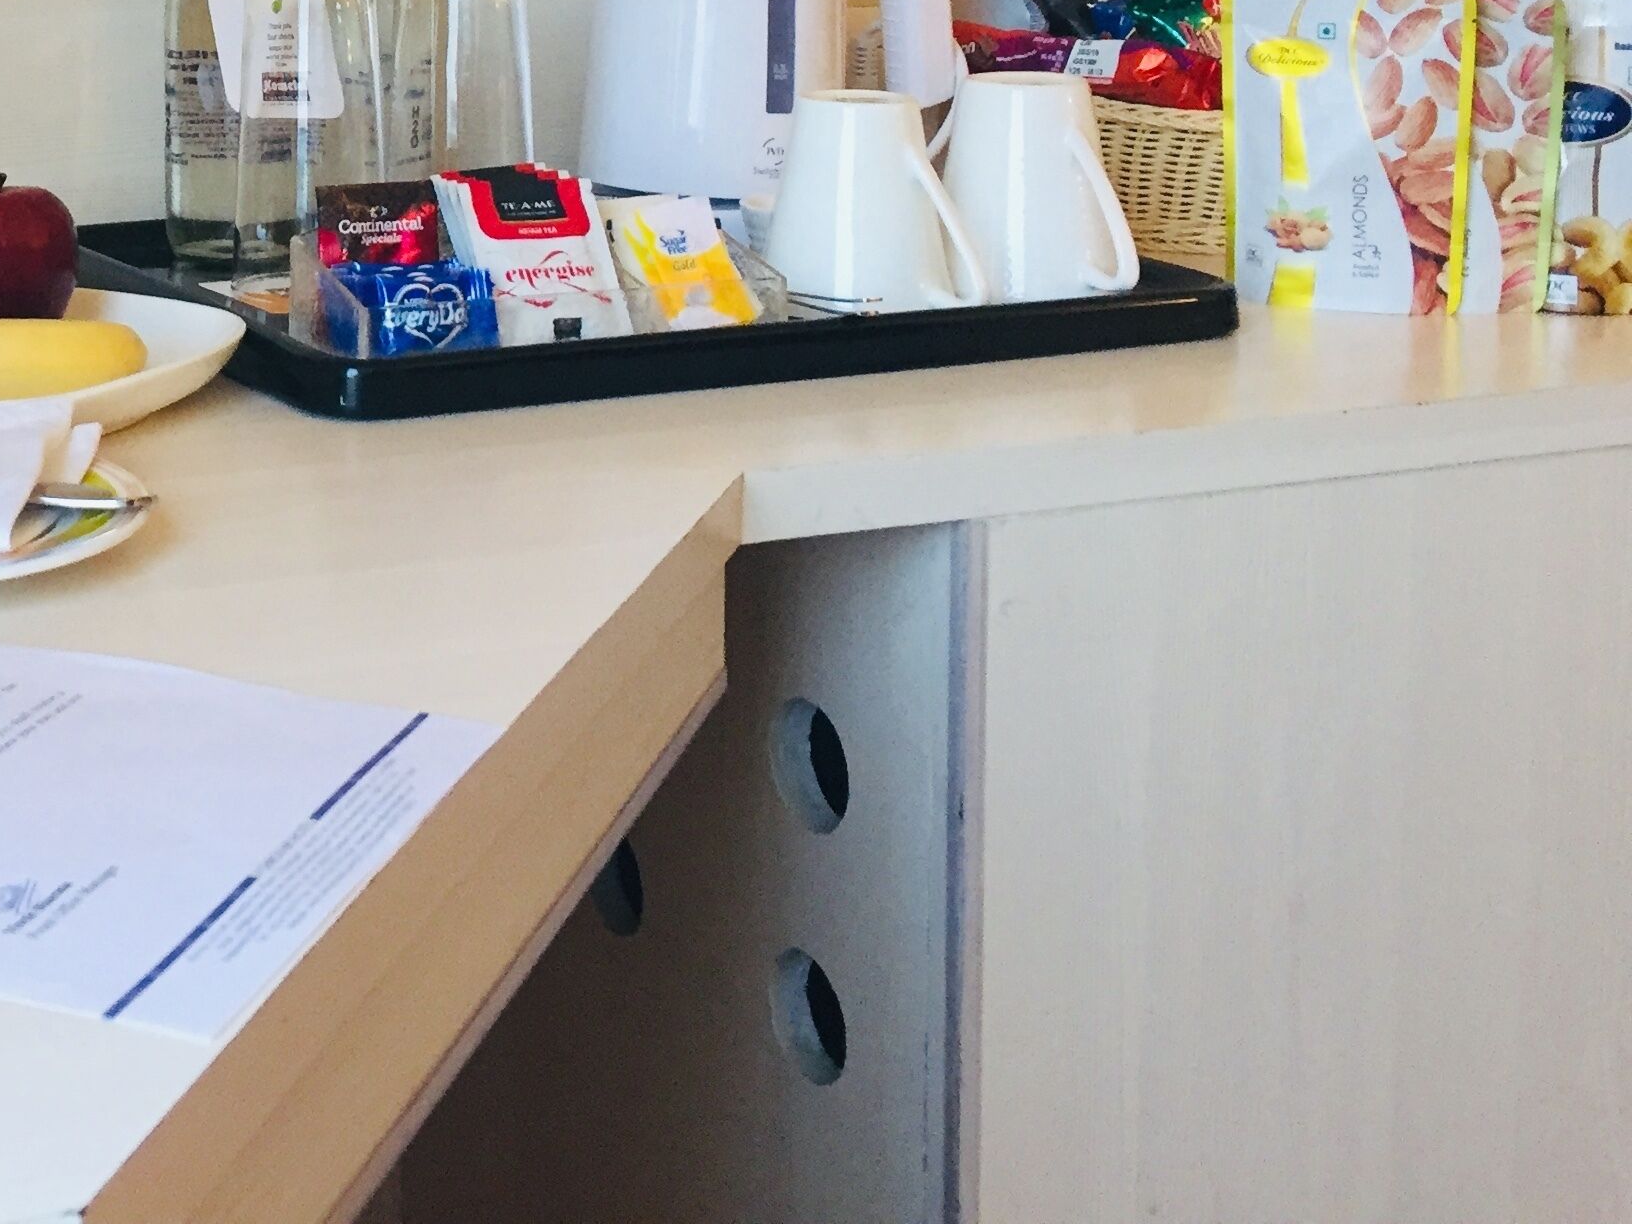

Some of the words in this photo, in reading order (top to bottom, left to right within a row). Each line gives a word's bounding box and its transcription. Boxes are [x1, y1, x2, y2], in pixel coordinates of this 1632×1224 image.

[338, 215, 424, 235] Continental
[1352, 174, 1368, 259] ALMONDS
[659, 235, 686, 249] Sugar
[667, 246, 687, 255] Free
[672, 258, 696, 272] Gold
[504, 260, 595, 290] energise
